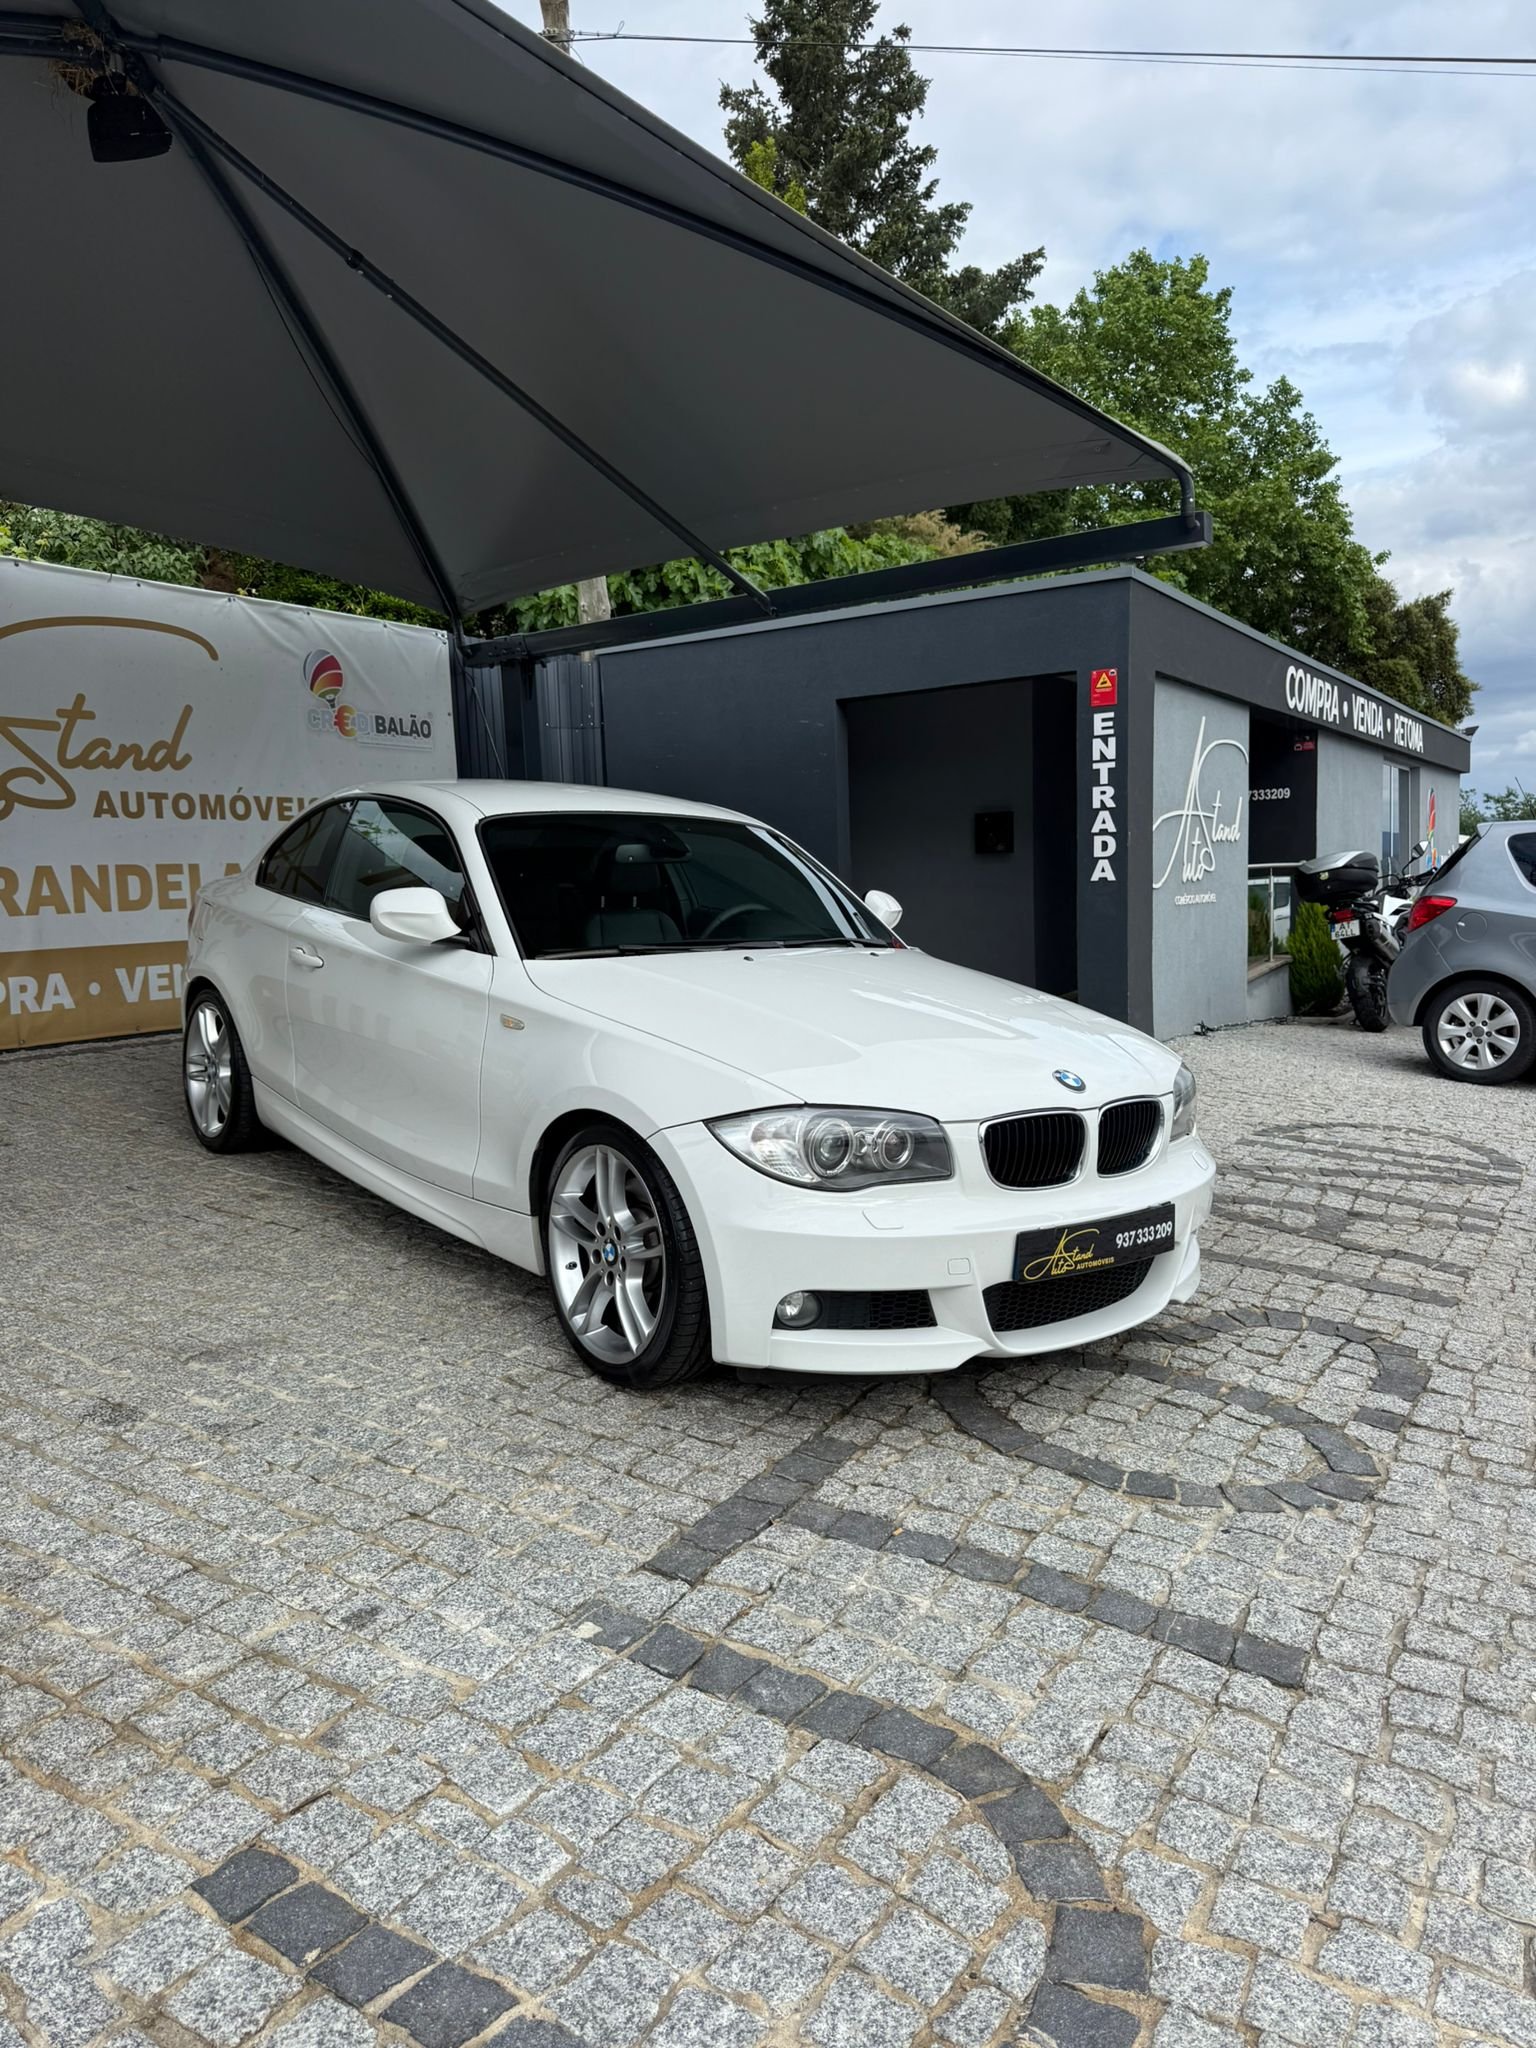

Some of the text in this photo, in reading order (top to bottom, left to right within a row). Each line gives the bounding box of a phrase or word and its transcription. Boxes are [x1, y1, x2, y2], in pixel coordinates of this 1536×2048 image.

[1286, 665, 1424, 754] COMPRA VENDA RETOMA
[1090, 711, 1117, 882] ENTRADA
[0, 963, 183, 1016] RA VE
[1115, 1220, 1173, 1249] 937 333 209
